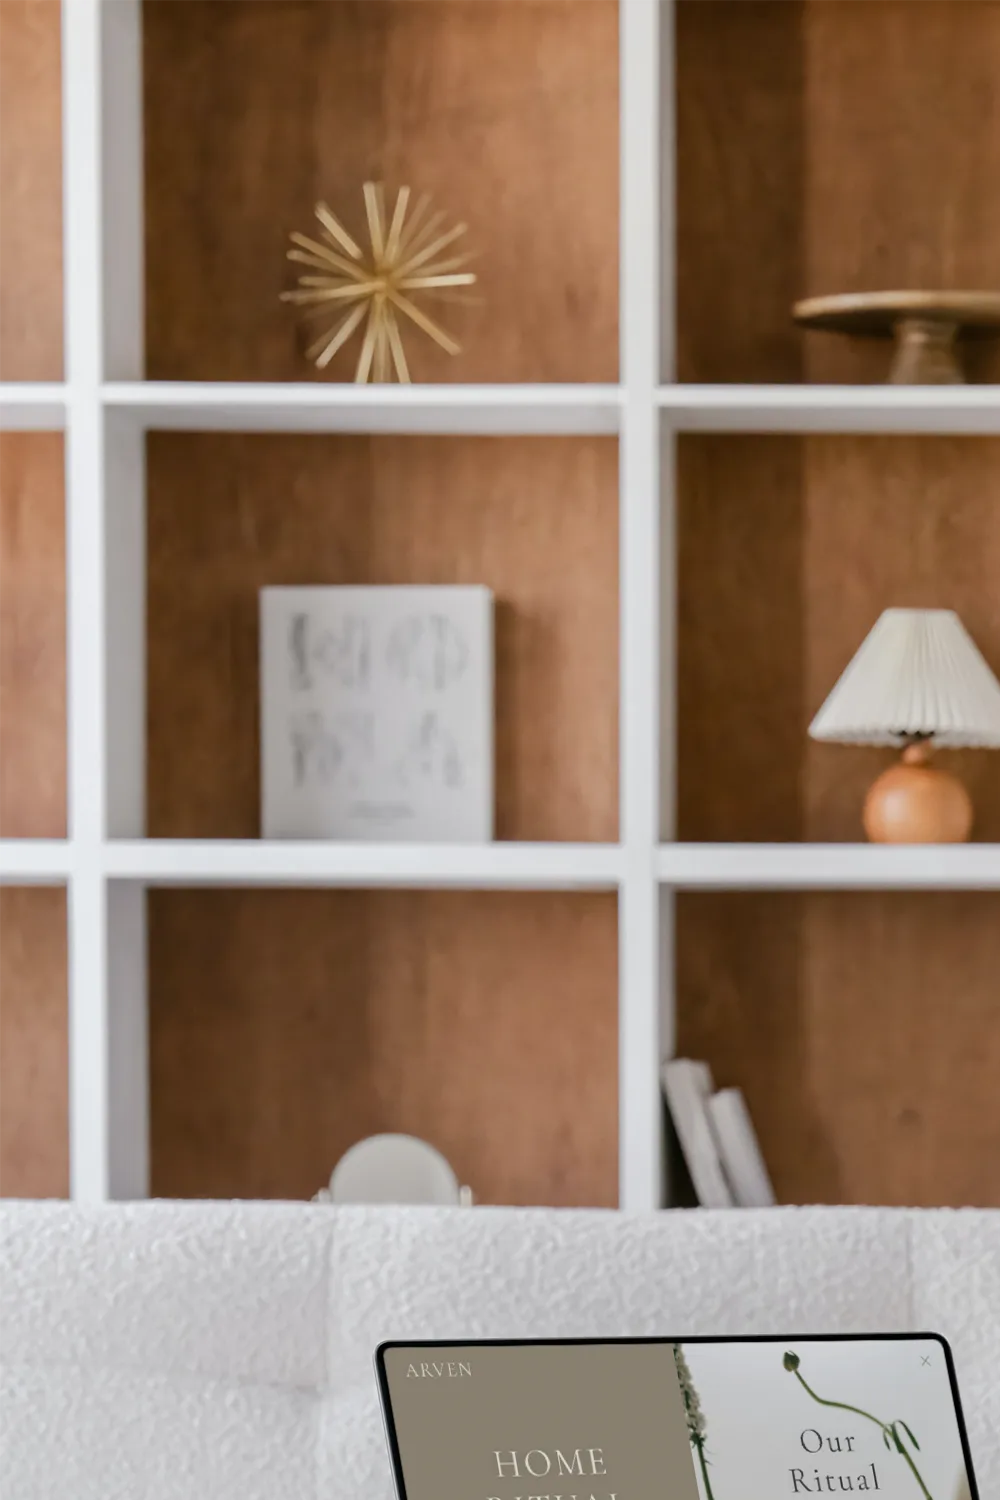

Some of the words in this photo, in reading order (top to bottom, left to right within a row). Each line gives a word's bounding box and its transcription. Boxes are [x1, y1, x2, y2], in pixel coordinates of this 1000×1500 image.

[406, 1362, 472, 1378] ARVEN
[799, 1428, 856, 1455] Our
[493, 1448, 608, 1478] HOME
[788, 1462, 881, 1493] Ritual
